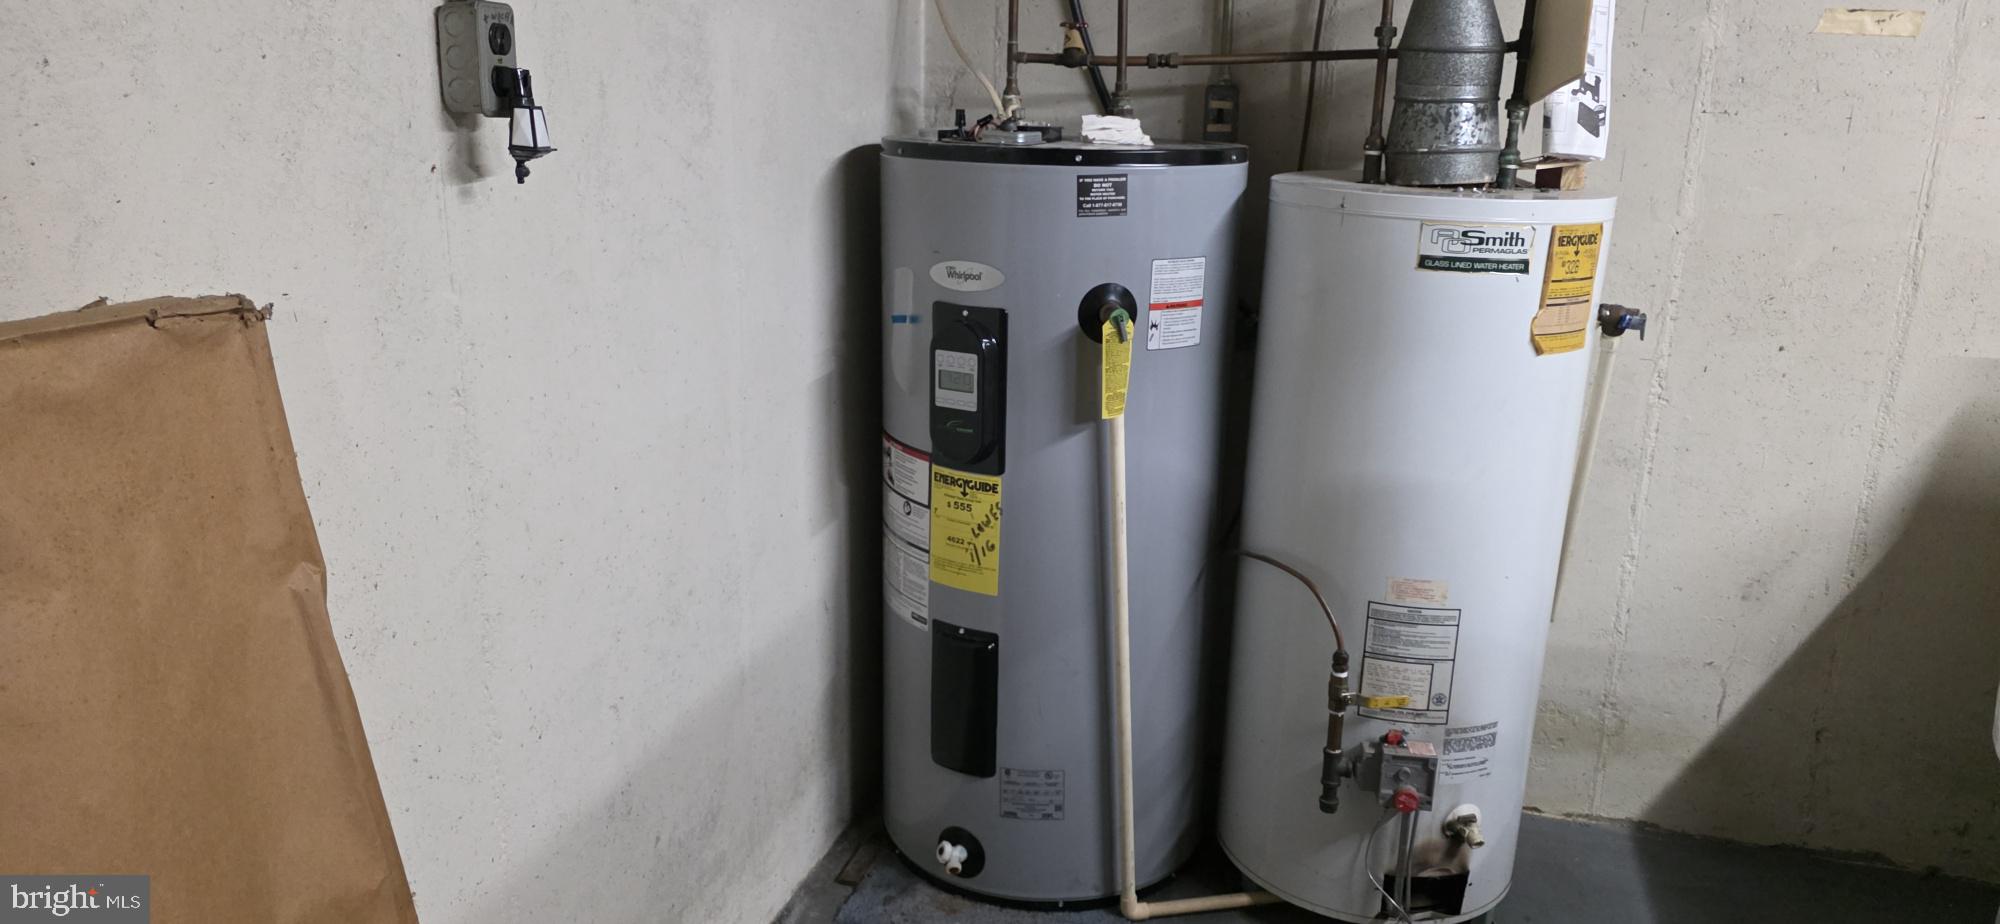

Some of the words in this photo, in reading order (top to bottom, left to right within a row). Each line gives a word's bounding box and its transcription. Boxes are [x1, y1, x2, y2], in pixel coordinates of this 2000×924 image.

[1460, 230, 1525, 247] Smith
[1472, 247, 1528, 255] PERMAGLAS
[1424, 259, 1450, 268] GLASS
[1450, 260, 1473, 269] LINED
[1473, 262, 1498, 270] WATER
[1499, 263, 1525, 271] HEATER
[946, 270, 983, 282] Whirlpool
[933, 472, 1000, 496] ENERGYGUIDE
[953, 501, 973, 513] 555
